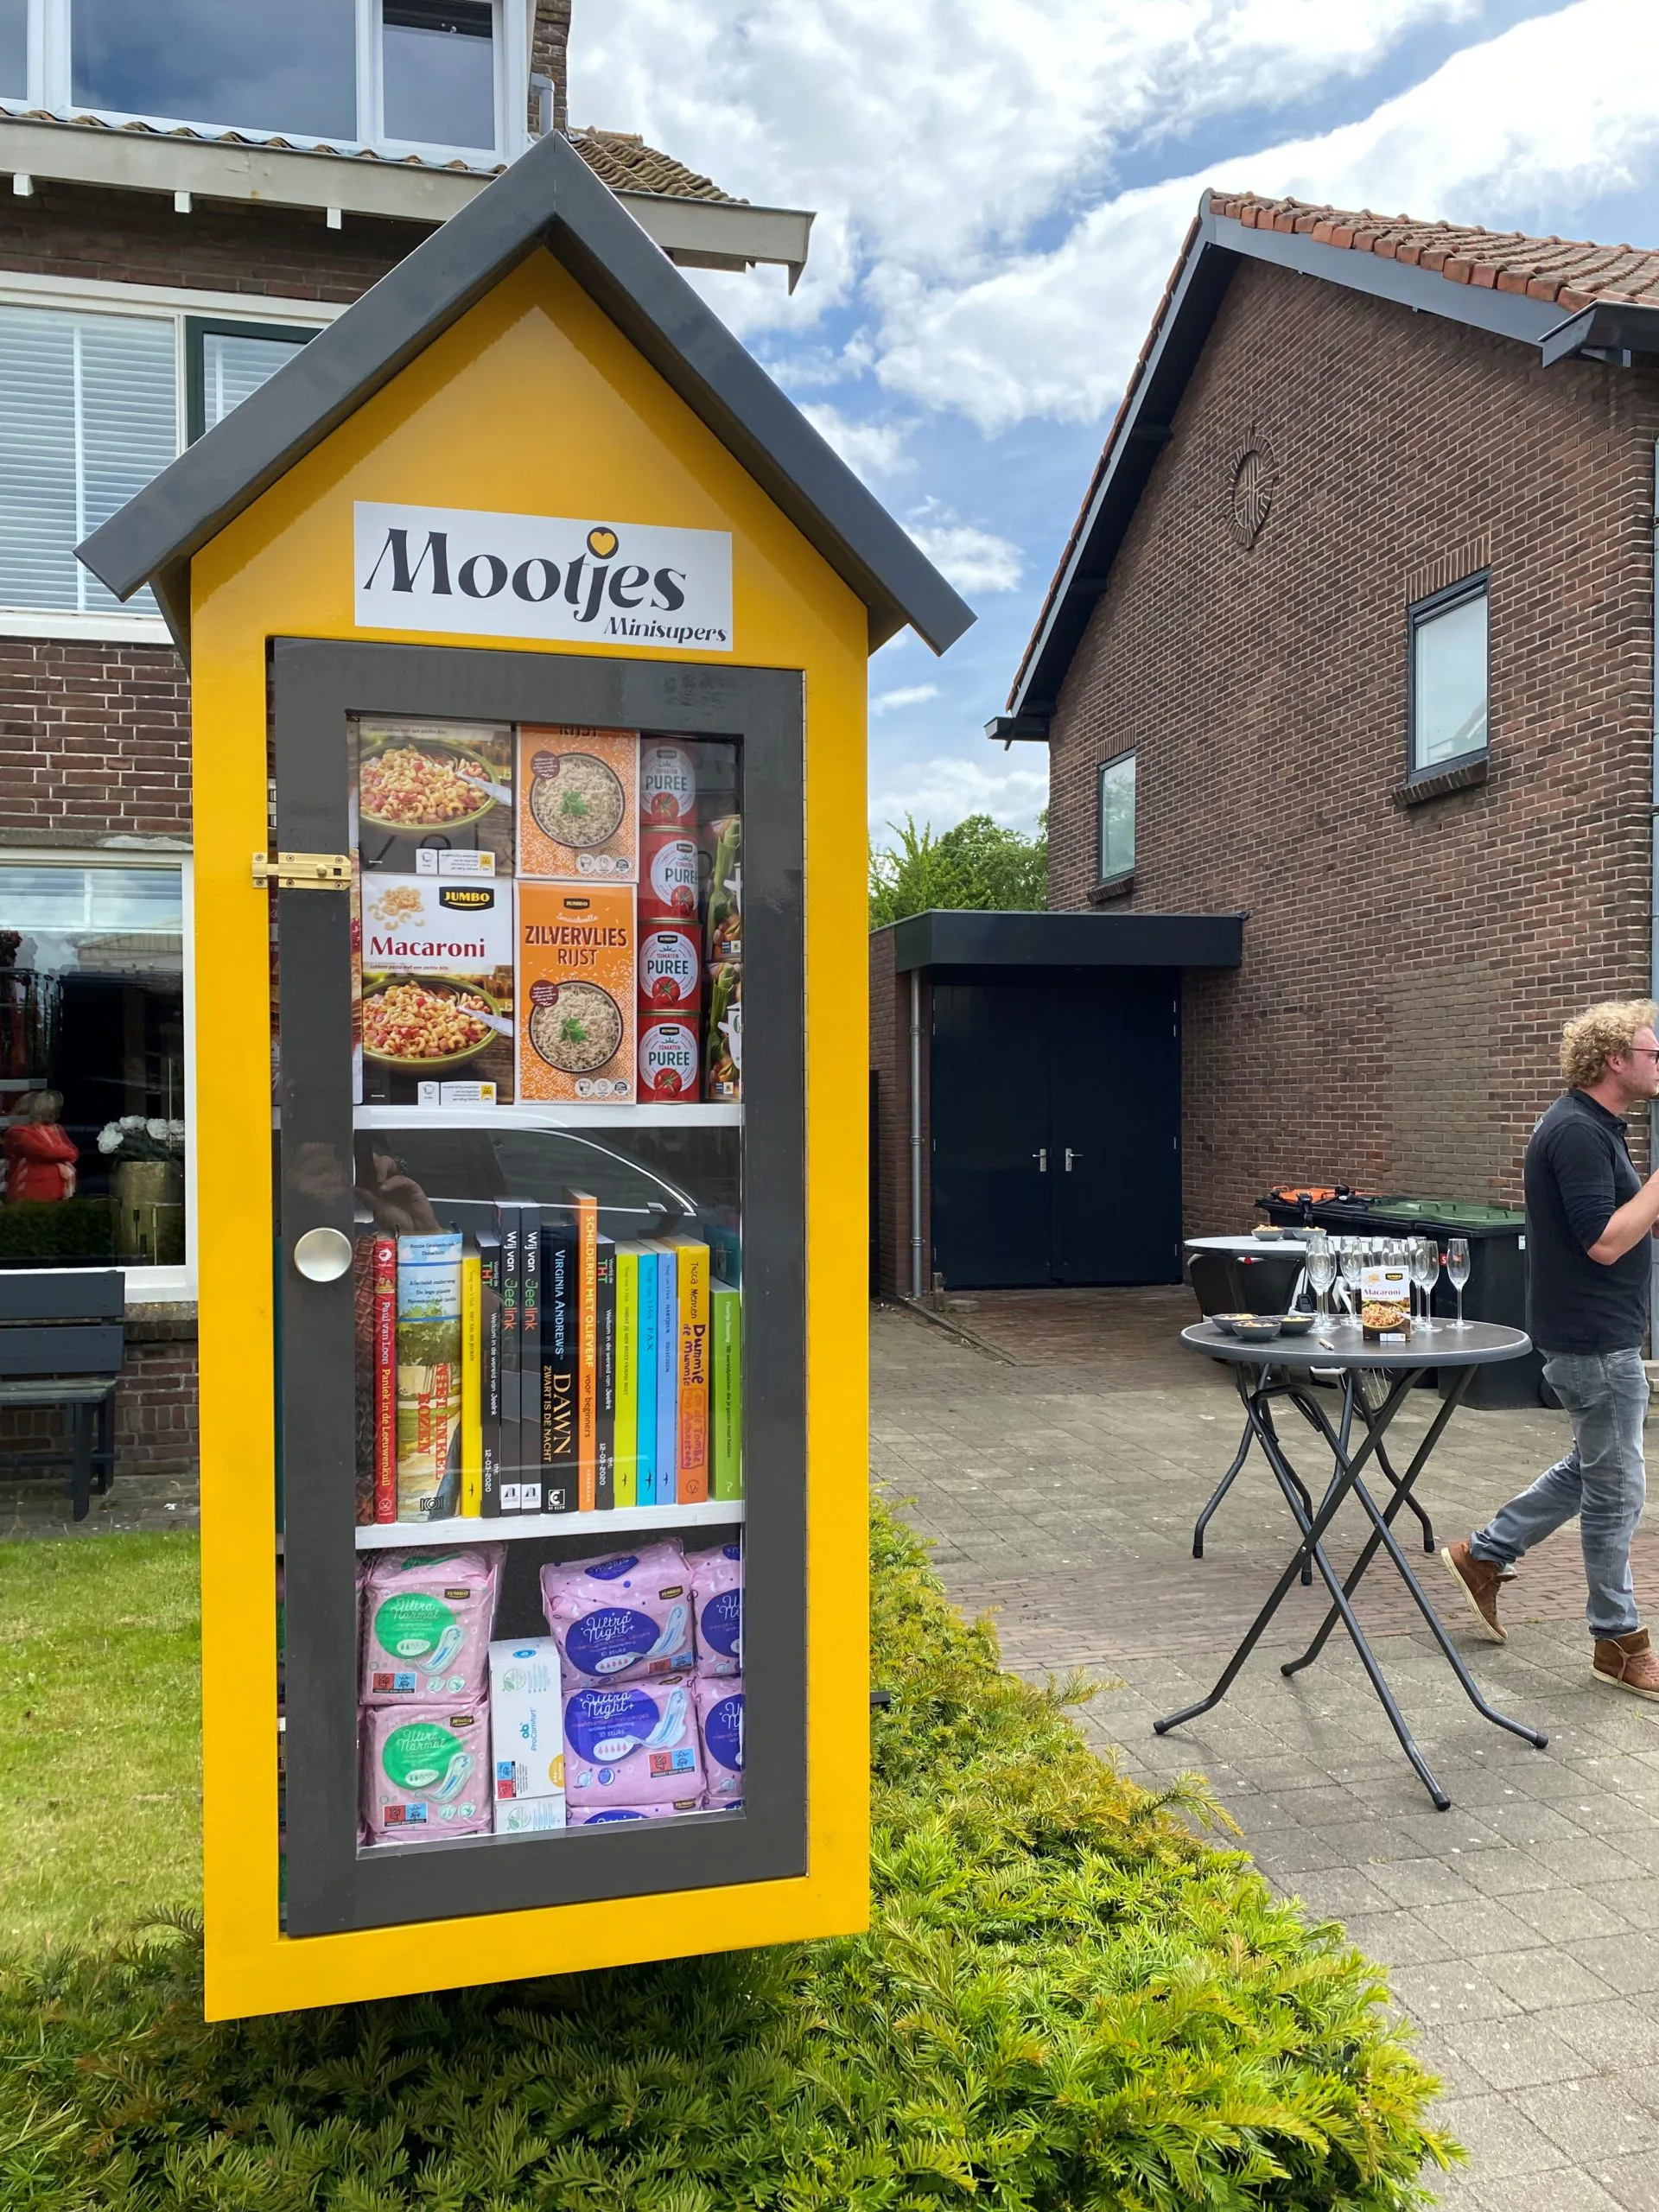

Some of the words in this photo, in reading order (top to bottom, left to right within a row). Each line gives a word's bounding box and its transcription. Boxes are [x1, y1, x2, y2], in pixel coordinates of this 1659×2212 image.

[363, 526, 687, 622] Mootjes
[605, 616, 727, 644] Minisupers
[645, 776, 688, 791] PUREE
[443, 892, 491, 902] JUMBO
[370, 936, 485, 957] Macaroni
[524, 925, 628, 947] ZILVERVLIES
[557, 949, 598, 967] RIJST
[647, 960, 689, 975] PUREE
[649, 1052, 690, 1066] PUREE
[504, 1230, 517, 1249] Wij
[524, 1231, 537, 1249] Wij
[585, 1215, 594, 1286] SCHILDEREN
[506, 1251, 515, 1272] van
[527, 1251, 536, 1272] van
[597, 1259, 608, 1284] THT
[482, 1262, 493, 1287] THT
[554, 1249, 566, 1298] VIRGINIA
[690, 1262, 699, 1285] Tosca
[504, 1278, 518, 1331] Jeelink
[524, 1278, 538, 1331] Jeelink
[585, 1288, 594, 1312] MET
[690, 1288, 699, 1319] Menten
[381, 1301, 391, 1322] Paul
[381, 1324, 390, 1340] van
[683, 1324, 691, 1336] de
[491, 1345, 497, 1356] de
[584, 1314, 594, 1369] OLIEVERF
[605, 1342, 612, 1351] de
[381, 1342, 391, 1364] Loon
[692, 1324, 707, 1384] Dummie
[381, 1369, 391, 1401] Paniek
[543, 1401, 551, 1411] IS
[553, 1373, 571, 1454] DAWN
[381, 1412, 391, 1425] de
[417, 1393, 430, 1454] ROZEN
[543, 1413, 551, 1427] DE
[583, 1397, 594, 1438] beginners
[435, 1414, 448, 1480] ENKEL
[543, 1428, 551, 1462] NACHT
[381, 1427, 391, 1486] Leeuwenkuil
[587, 1612, 632, 1632] Ultra
[404, 1729, 440, 1743] Ultra
[530, 1709, 538, 1751] ProComfort
